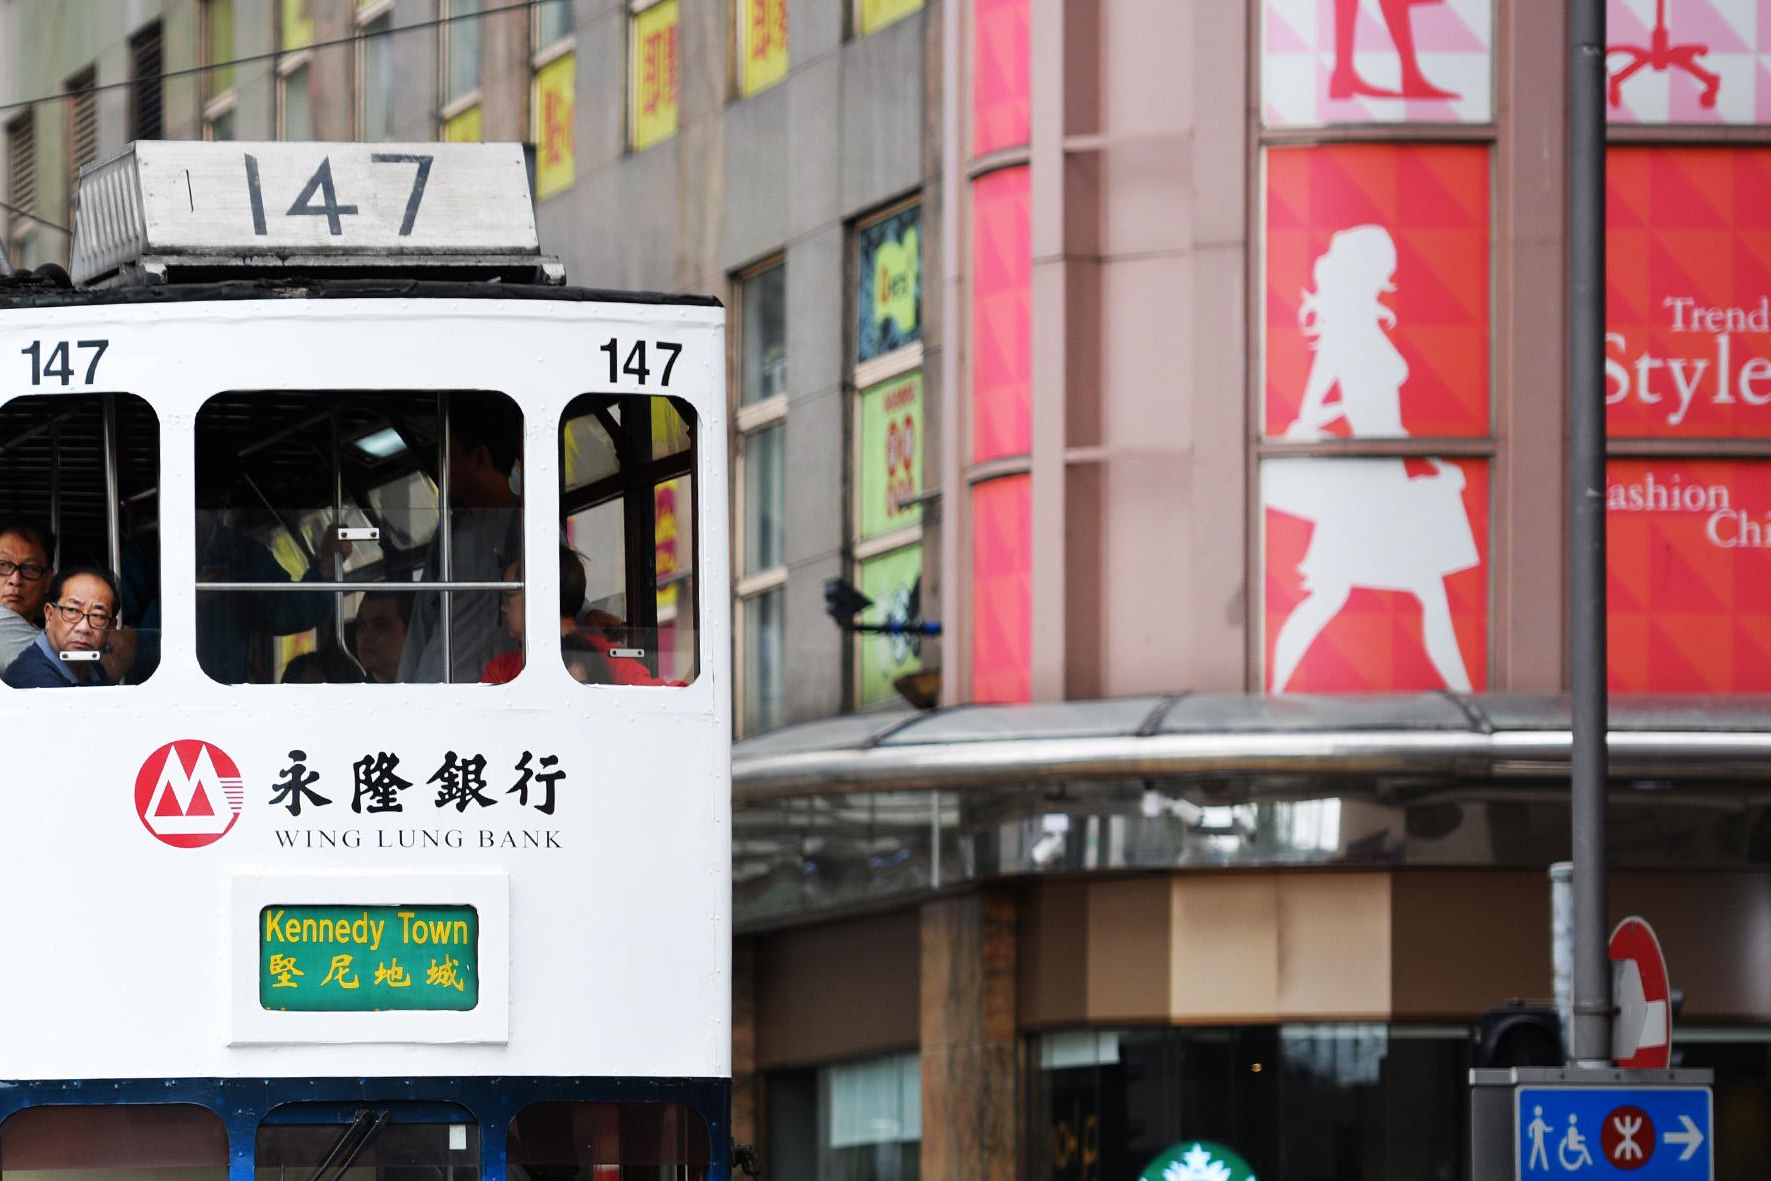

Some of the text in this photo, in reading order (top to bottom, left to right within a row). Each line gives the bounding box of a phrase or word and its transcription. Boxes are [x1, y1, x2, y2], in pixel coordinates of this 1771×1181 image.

[244, 153, 434, 237] 147
[1663, 296, 1771, 333] Trend
[21, 340, 110, 386] 147
[600, 339, 683, 388] 147
[1605, 332, 1771, 425] Style
[1606, 472, 1729, 512] ashion
[268, 750, 567, 816] 永隆銀行
[275, 830, 563, 848] WING LUNG BANK
[266, 910, 468, 951] Kennedy Town
[269, 954, 466, 991] 堅尼地城
